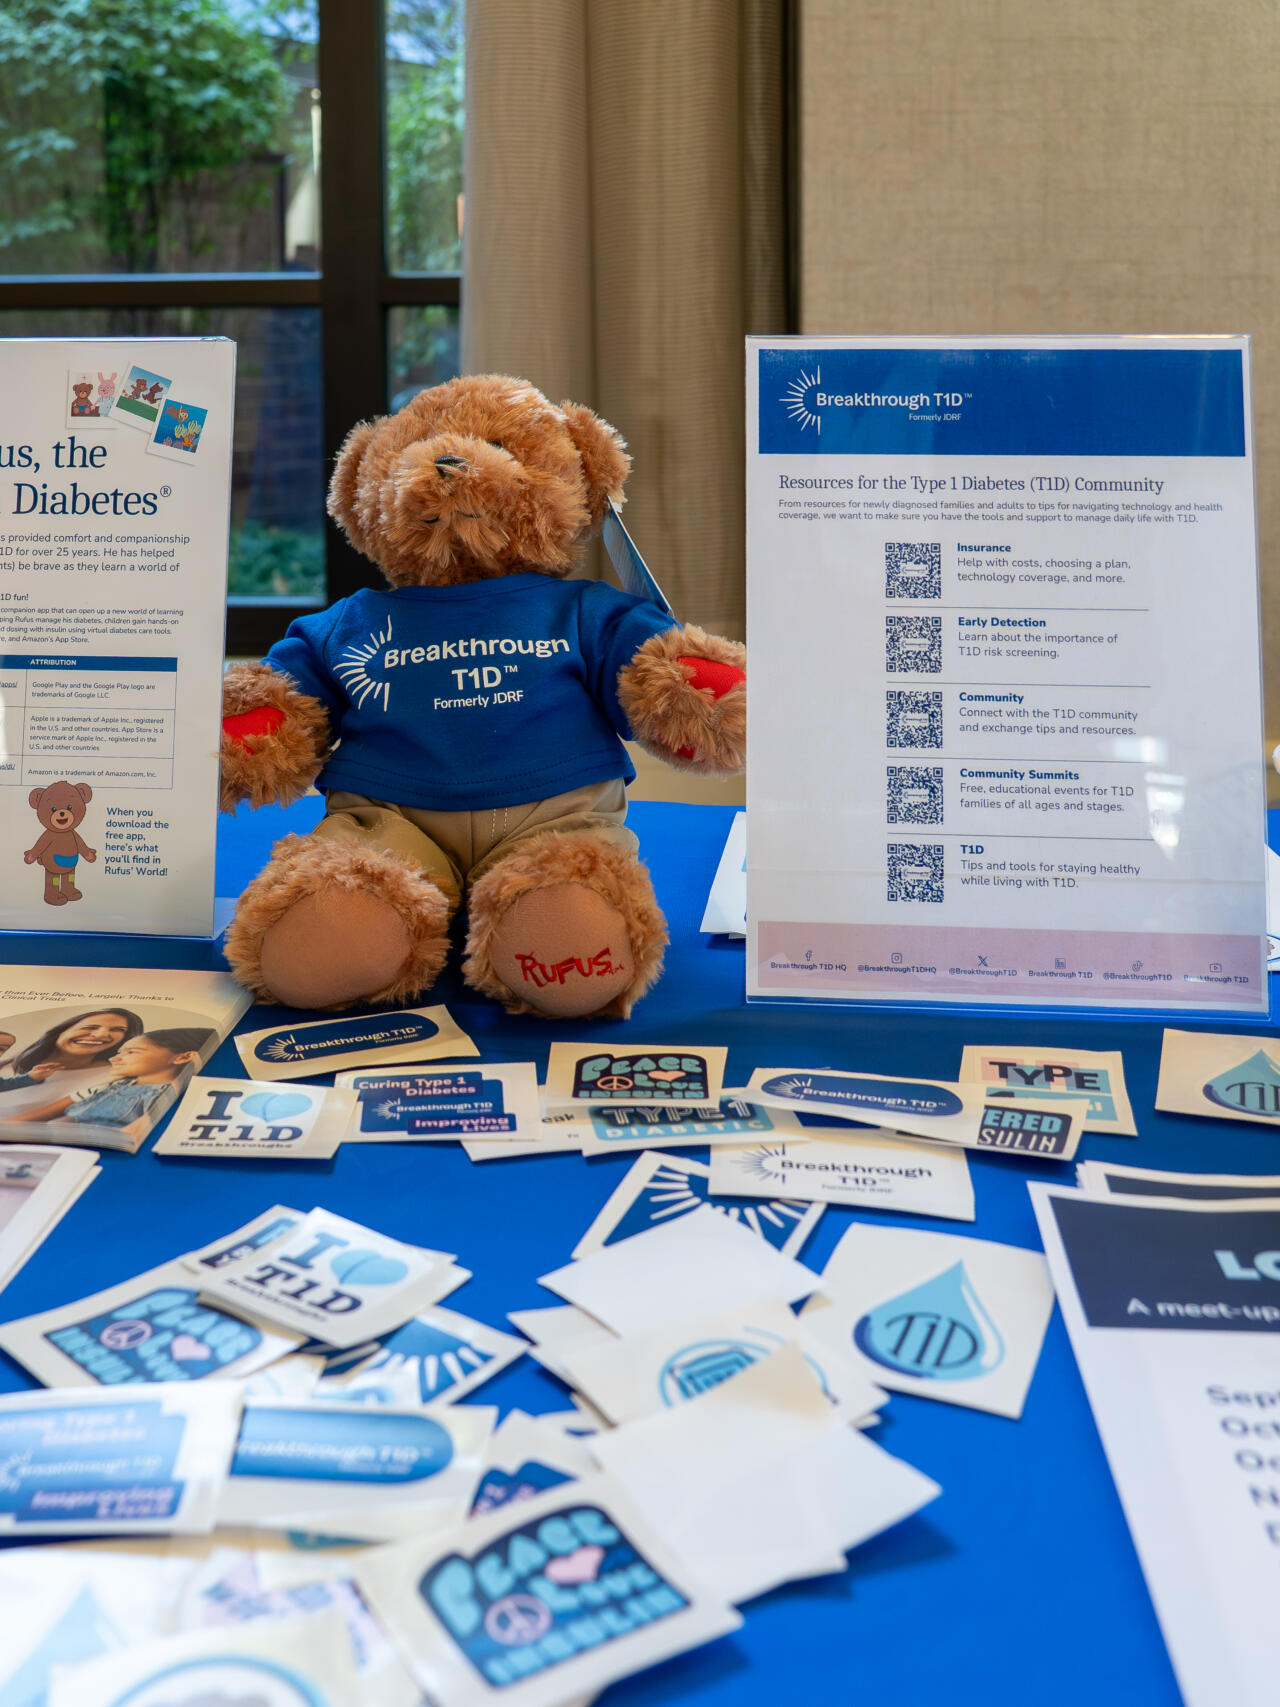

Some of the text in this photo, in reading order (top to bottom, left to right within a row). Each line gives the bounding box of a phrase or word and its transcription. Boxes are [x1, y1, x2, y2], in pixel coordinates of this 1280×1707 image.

[816, 392, 930, 411] Breakthrough
[908, 412, 962, 422] Formerly JDRF
[51, 435, 107, 468] the
[778, 474, 1165, 496] Resources for the Type 1 Diabetes (T1D) Community
[7, 532, 51, 544] provided
[53, 532, 92, 543] comfort
[93, 533, 113, 543] and
[114, 534, 190, 545] companionship
[15, 546, 30, 556] for
[31, 548, 54, 557] over
[55, 546, 69, 557] 25
[71, 548, 101, 559] years.
[103, 547, 118, 557] He
[120, 547, 138, 557] has
[139, 547, 175, 559] helped
[956, 542, 1012, 553] Insurance
[957, 556, 1131, 570] Help with costs, choosing a plan,
[956, 571, 1125, 584] technology coverage, and more.
[12, 592, 29, 601] fun!
[957, 616, 1046, 628] Early Detection
[958, 631, 1118, 644] Learn about the importance of
[384, 638, 570, 669] Breakthrough
[29, 658, 77, 666] ATTRIBUTION
[434, 690, 524, 711] Formerly JDRF
[958, 691, 1024, 705] Community
[959, 767, 1080, 781] Community Summits
[105, 807, 153, 818] When you
[105, 818, 169, 829] download the
[104, 830, 146, 842] free app,
[104, 842, 159, 853] here's what
[959, 843, 984, 855] T1D
[103, 854, 161, 867] you'll find in
[104, 865, 168, 877] Rufus' World!
[294, 1030, 390, 1052] Breakthrough
[988, 1060, 1101, 1092] TYPE
[358, 1076, 467, 1091] Curing Type 1
[405, 1085, 476, 1097] Diabetes
[802, 1087, 908, 1107] Breakthrough
[195, 1090, 244, 1121] I
[396, 1103, 472, 1113] Breakthrough
[414, 1116, 510, 1128] Improving
[982, 1108, 1063, 1133] ERED
[188, 1124, 304, 1142] T1D
[606, 1120, 765, 1139] DIABETIC
[780, 1159, 934, 1178] Breakthrough
[279, 1232, 350, 1270] I
[244, 1264, 363, 1316] T1D
[1126, 1297, 1280, 1324] A meet-up
[1206, 1384, 1280, 1409] Sep
